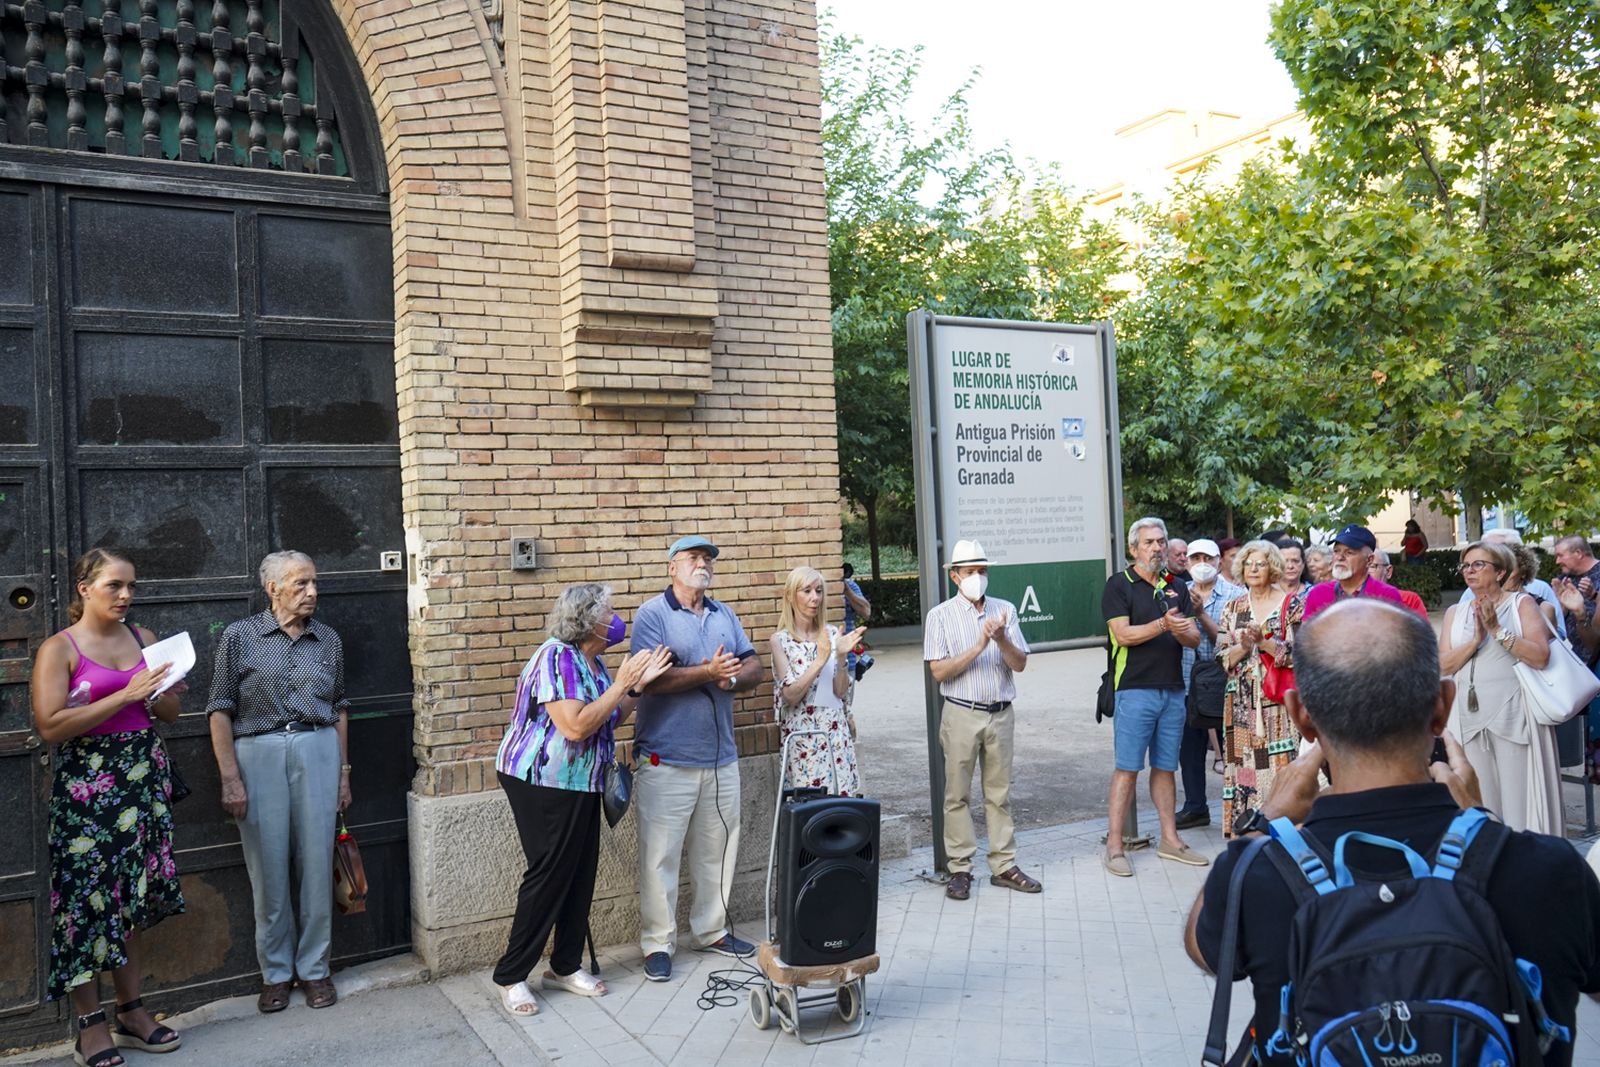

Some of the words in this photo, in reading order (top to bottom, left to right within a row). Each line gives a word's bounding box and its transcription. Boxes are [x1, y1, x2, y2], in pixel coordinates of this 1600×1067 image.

[952, 351, 991, 368] LUGAR
[996, 353, 1011, 368] DE
[953, 372, 1013, 389] MEMORIA
[1016, 371, 1078, 391] HISTÓRICA
[954, 393, 970, 409] DE
[975, 391, 1042, 410] ANDALUCÍA
[956, 423, 1006, 444] Antigua
[1011, 424, 1055, 440] Prisión
[957, 446, 1022, 462] Provincial
[1027, 446, 1042, 462] de
[958, 468, 1014, 485] Granada
